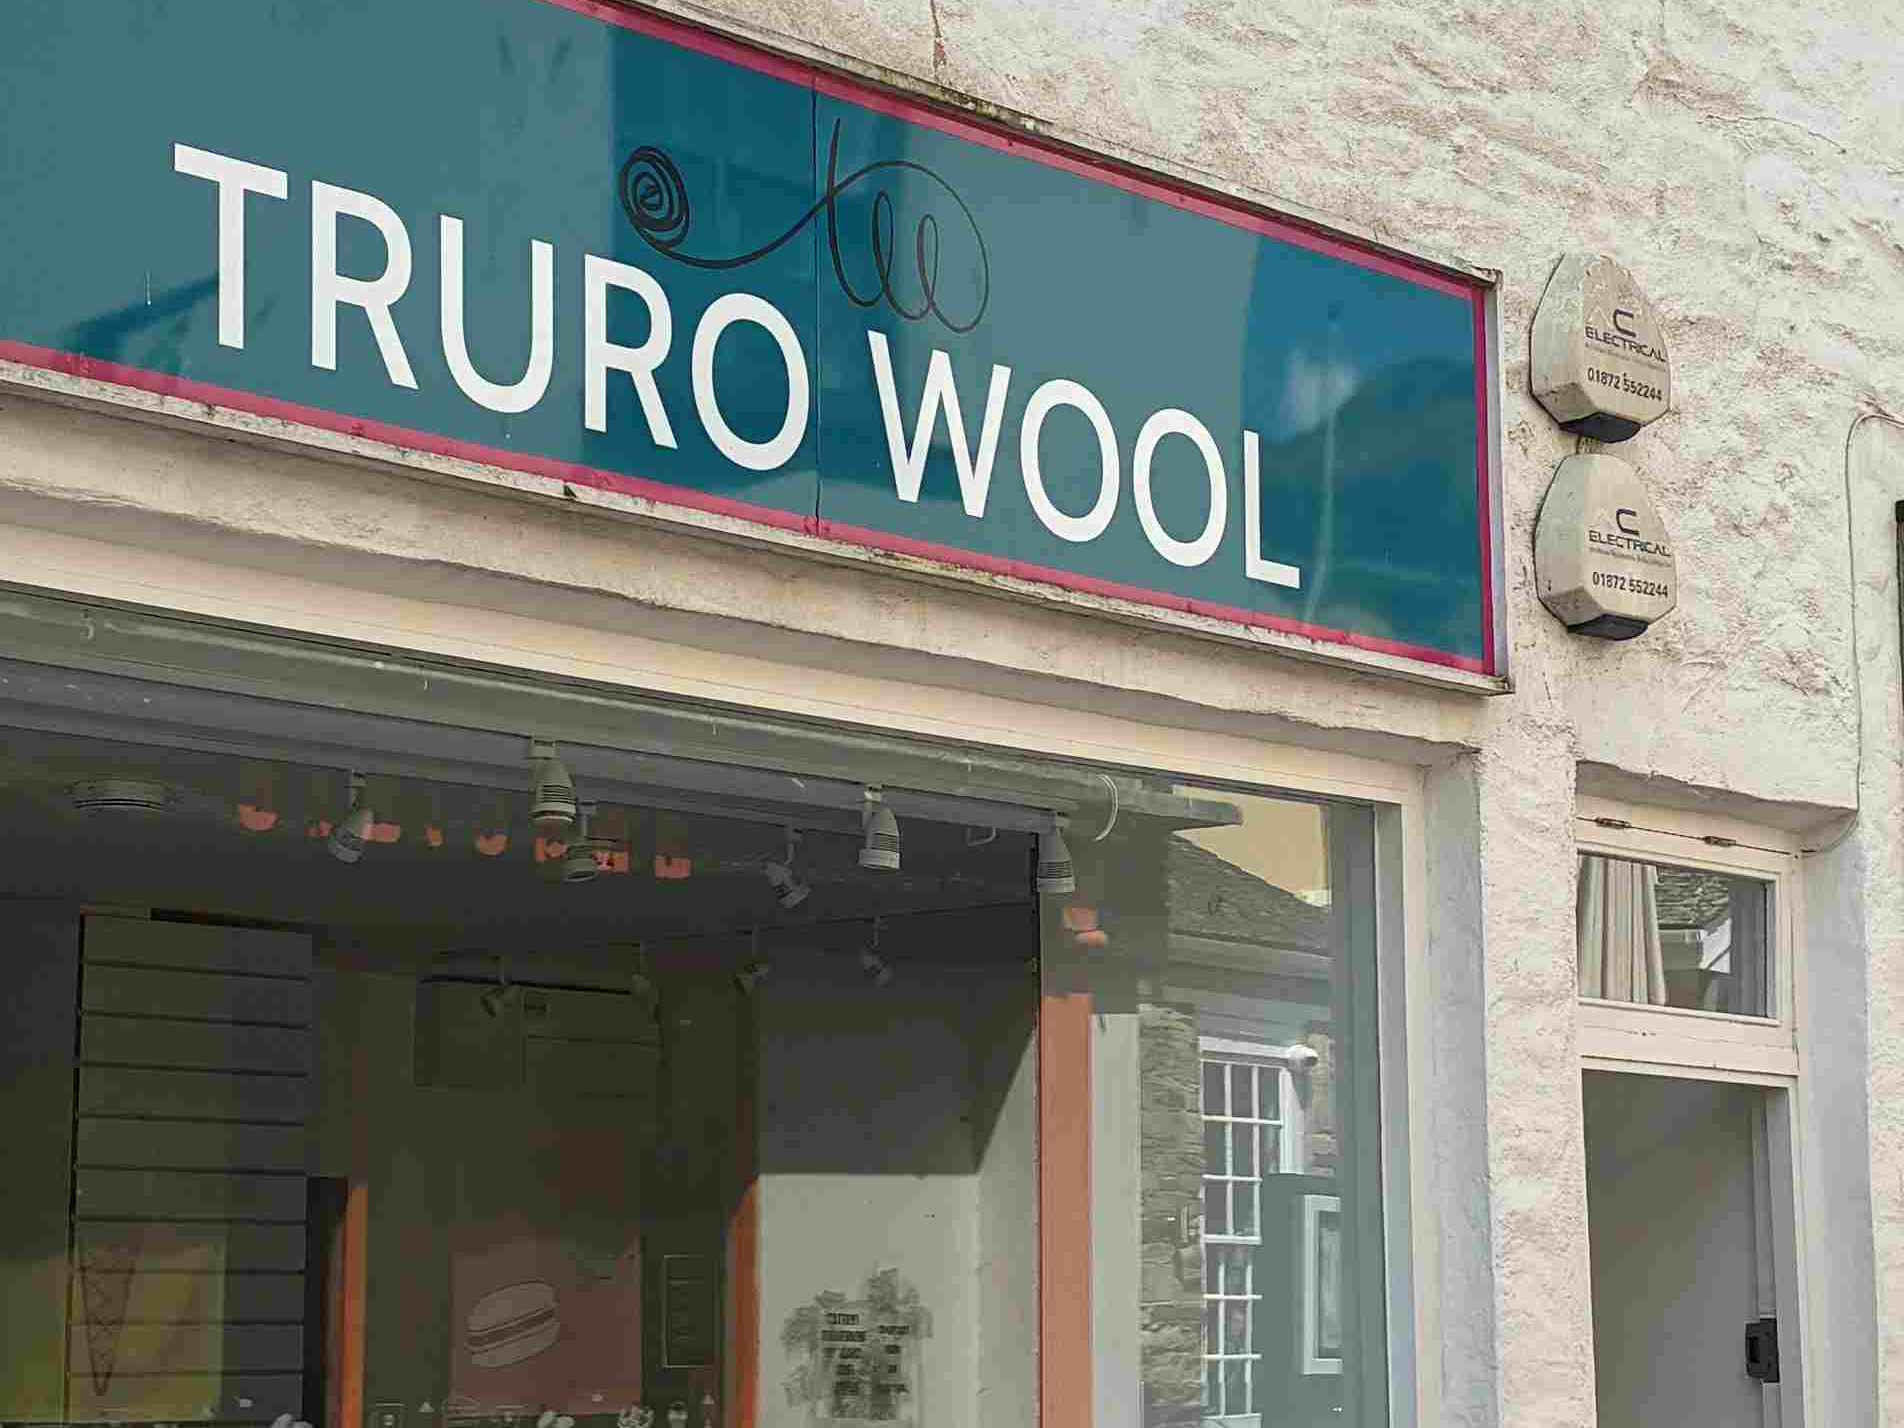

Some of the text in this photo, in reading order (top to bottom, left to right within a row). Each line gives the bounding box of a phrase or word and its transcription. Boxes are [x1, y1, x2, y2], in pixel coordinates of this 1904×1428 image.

[1585, 326, 1667, 363] ELECTRICAL
[173, 143, 1302, 589] TRURO WOOL
[1587, 367, 1662, 402] 01872 552244
[1589, 530, 1672, 558] ELECTRICAL
[1592, 571, 1669, 598] 01872 552244
